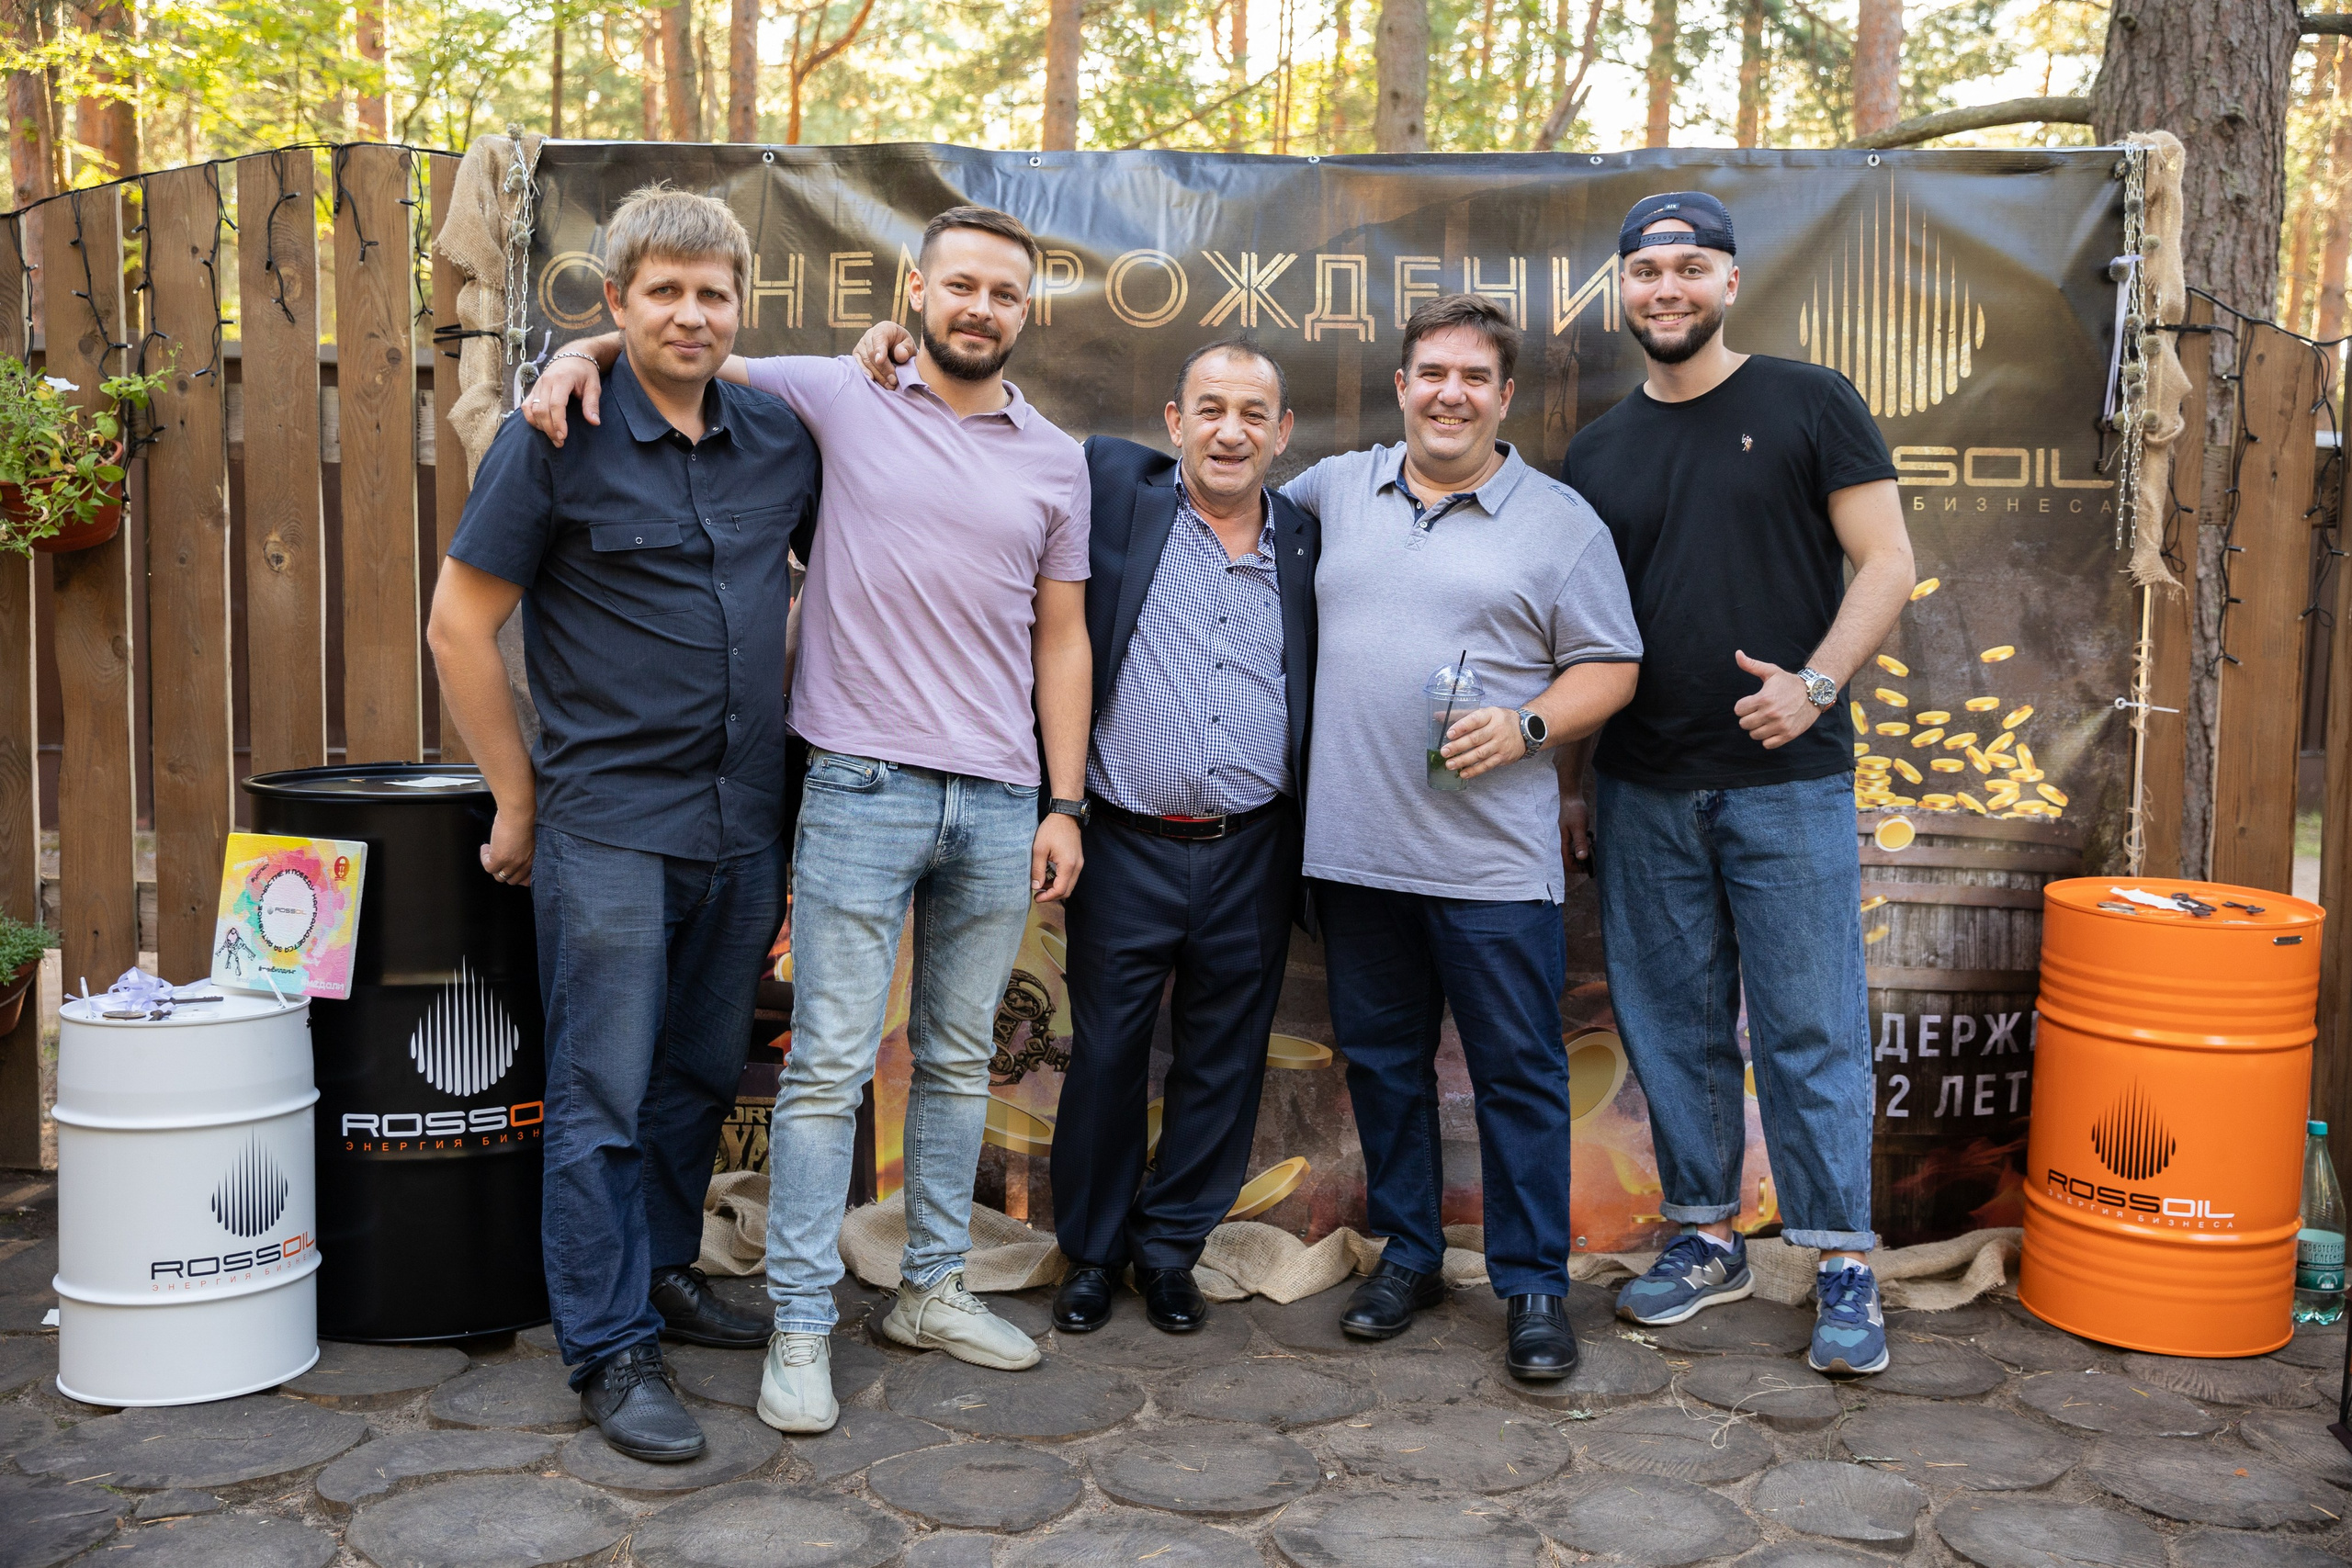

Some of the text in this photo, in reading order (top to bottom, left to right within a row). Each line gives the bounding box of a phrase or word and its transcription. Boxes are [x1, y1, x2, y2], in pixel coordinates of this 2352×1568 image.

[537, 241, 1620, 343] С НЕ РОЖДЕНИ
[1892, 446, 2115, 489] SOIL
[1913, 496, 2113, 513] БИЗНЕСА
[1934, 1070, 2028, 1118] ЛЕТ
[342, 1100, 544, 1138] ROSSO
[345, 1128, 540, 1152] ЭНЕРГИЯ БИЗН
[2047, 1168, 2235, 1219] ROSSOIL
[2047, 1188, 2233, 1229] ЭНЕРГИЯ БИЗНЕСА
[151, 1231, 315, 1280] ROSSOIL
[152, 1272, 252, 1292] ЭНЕРГИЯ
